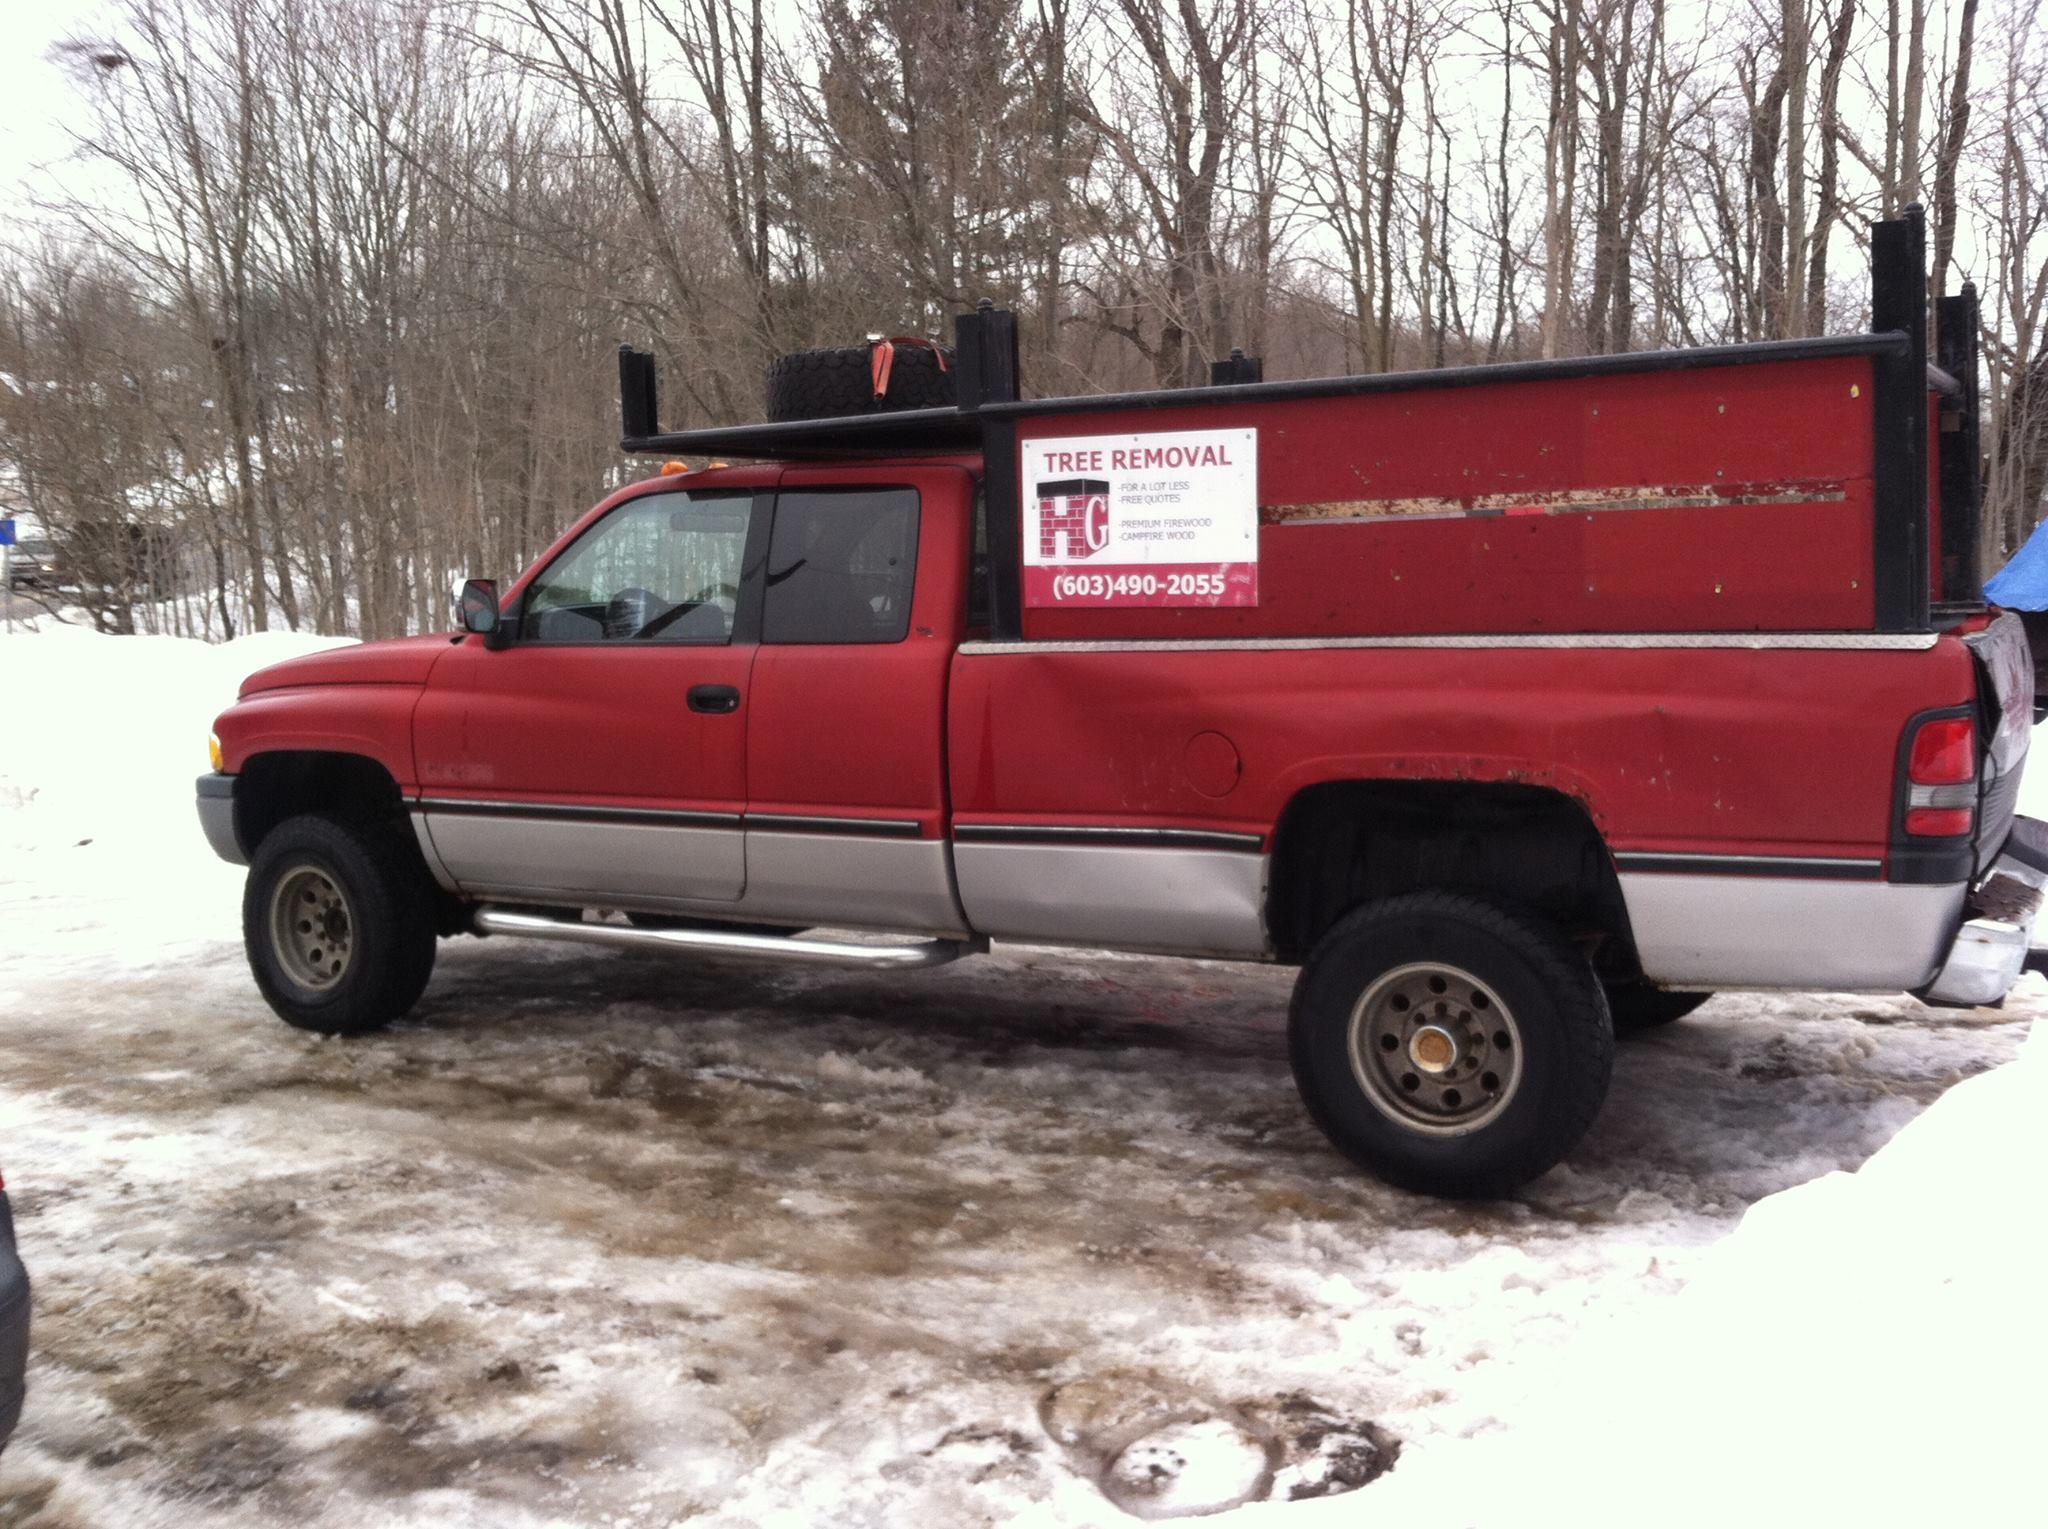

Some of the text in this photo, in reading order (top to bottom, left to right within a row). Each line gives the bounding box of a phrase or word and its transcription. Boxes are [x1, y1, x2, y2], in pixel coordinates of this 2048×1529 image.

[1043, 445, 1233, 473] TREE REMOVAL
[1140, 482, 1147, 492] A
[1149, 481, 1166, 491] LOT
[1168, 480, 1191, 491] LESS
[1144, 494, 1182, 505] QUOTES
[1163, 518, 1213, 528] FIREWOOD
[1166, 530, 1196, 540] WOOD
[1053, 574, 1226, 601] (603)490-2055
